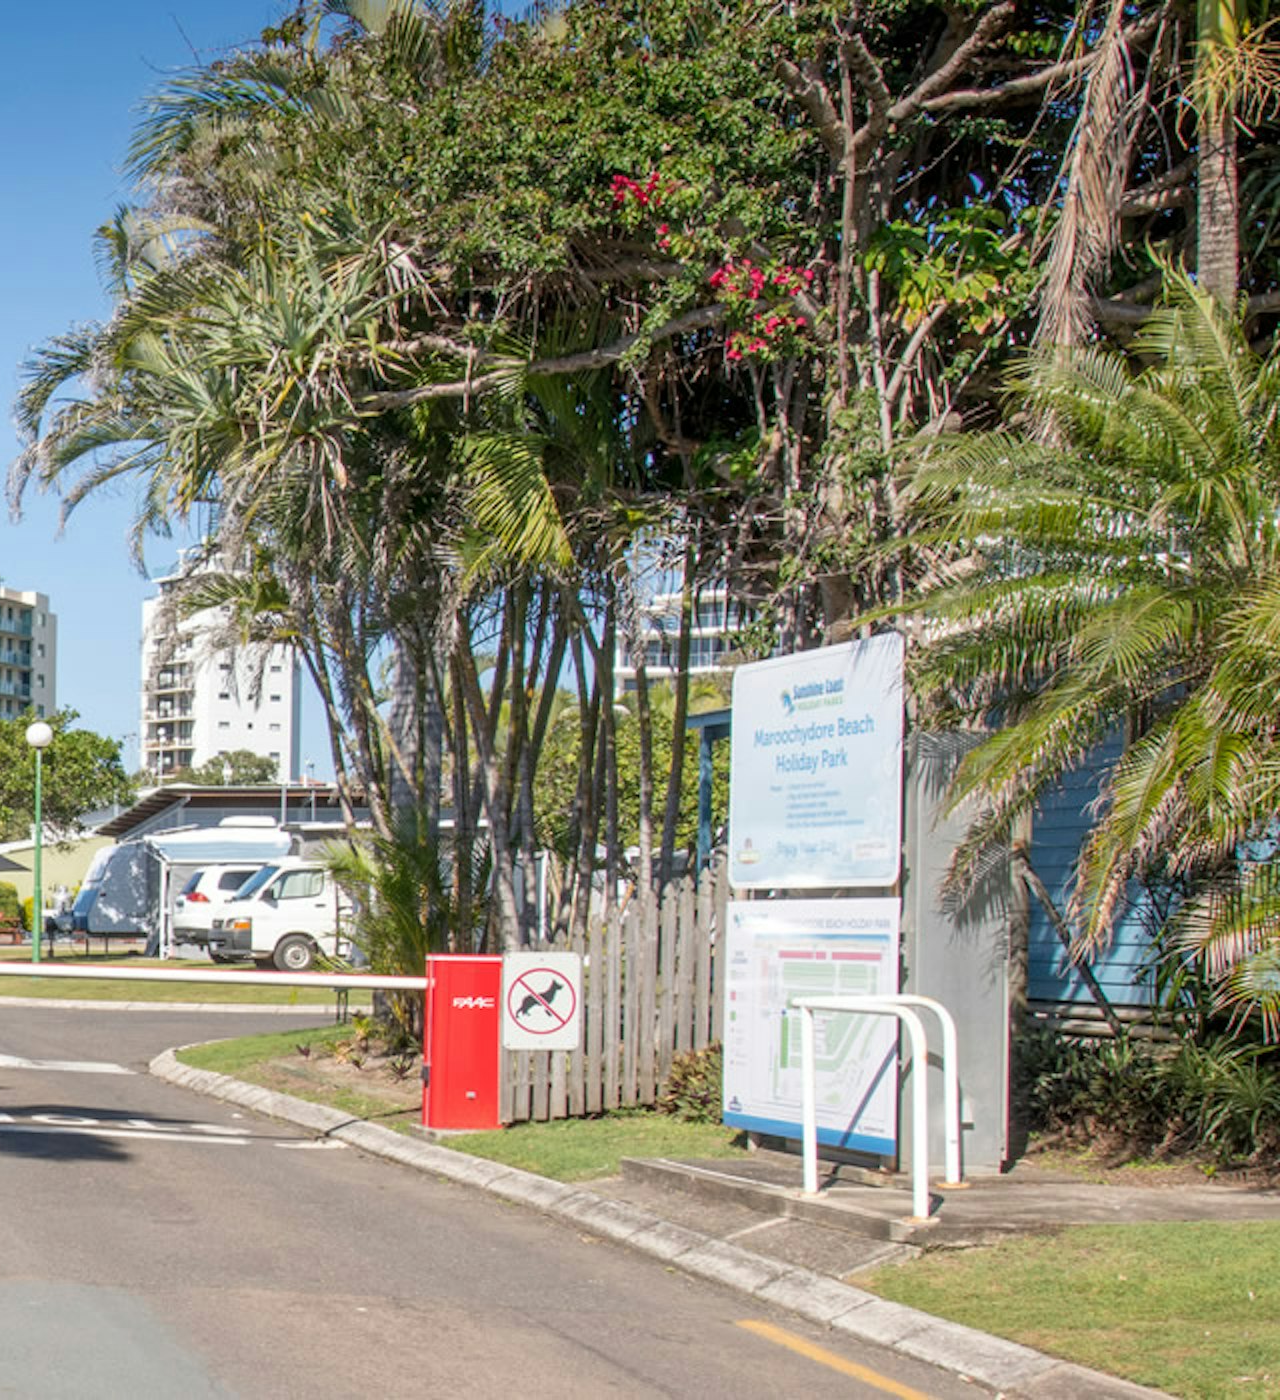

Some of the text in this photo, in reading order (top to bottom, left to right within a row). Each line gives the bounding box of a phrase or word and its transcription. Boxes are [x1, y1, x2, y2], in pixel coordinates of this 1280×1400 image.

[753, 713, 876, 749] Maroochydore Beach
[775, 746, 849, 775] Holiday Park
[452, 996, 496, 1009] FAAC
